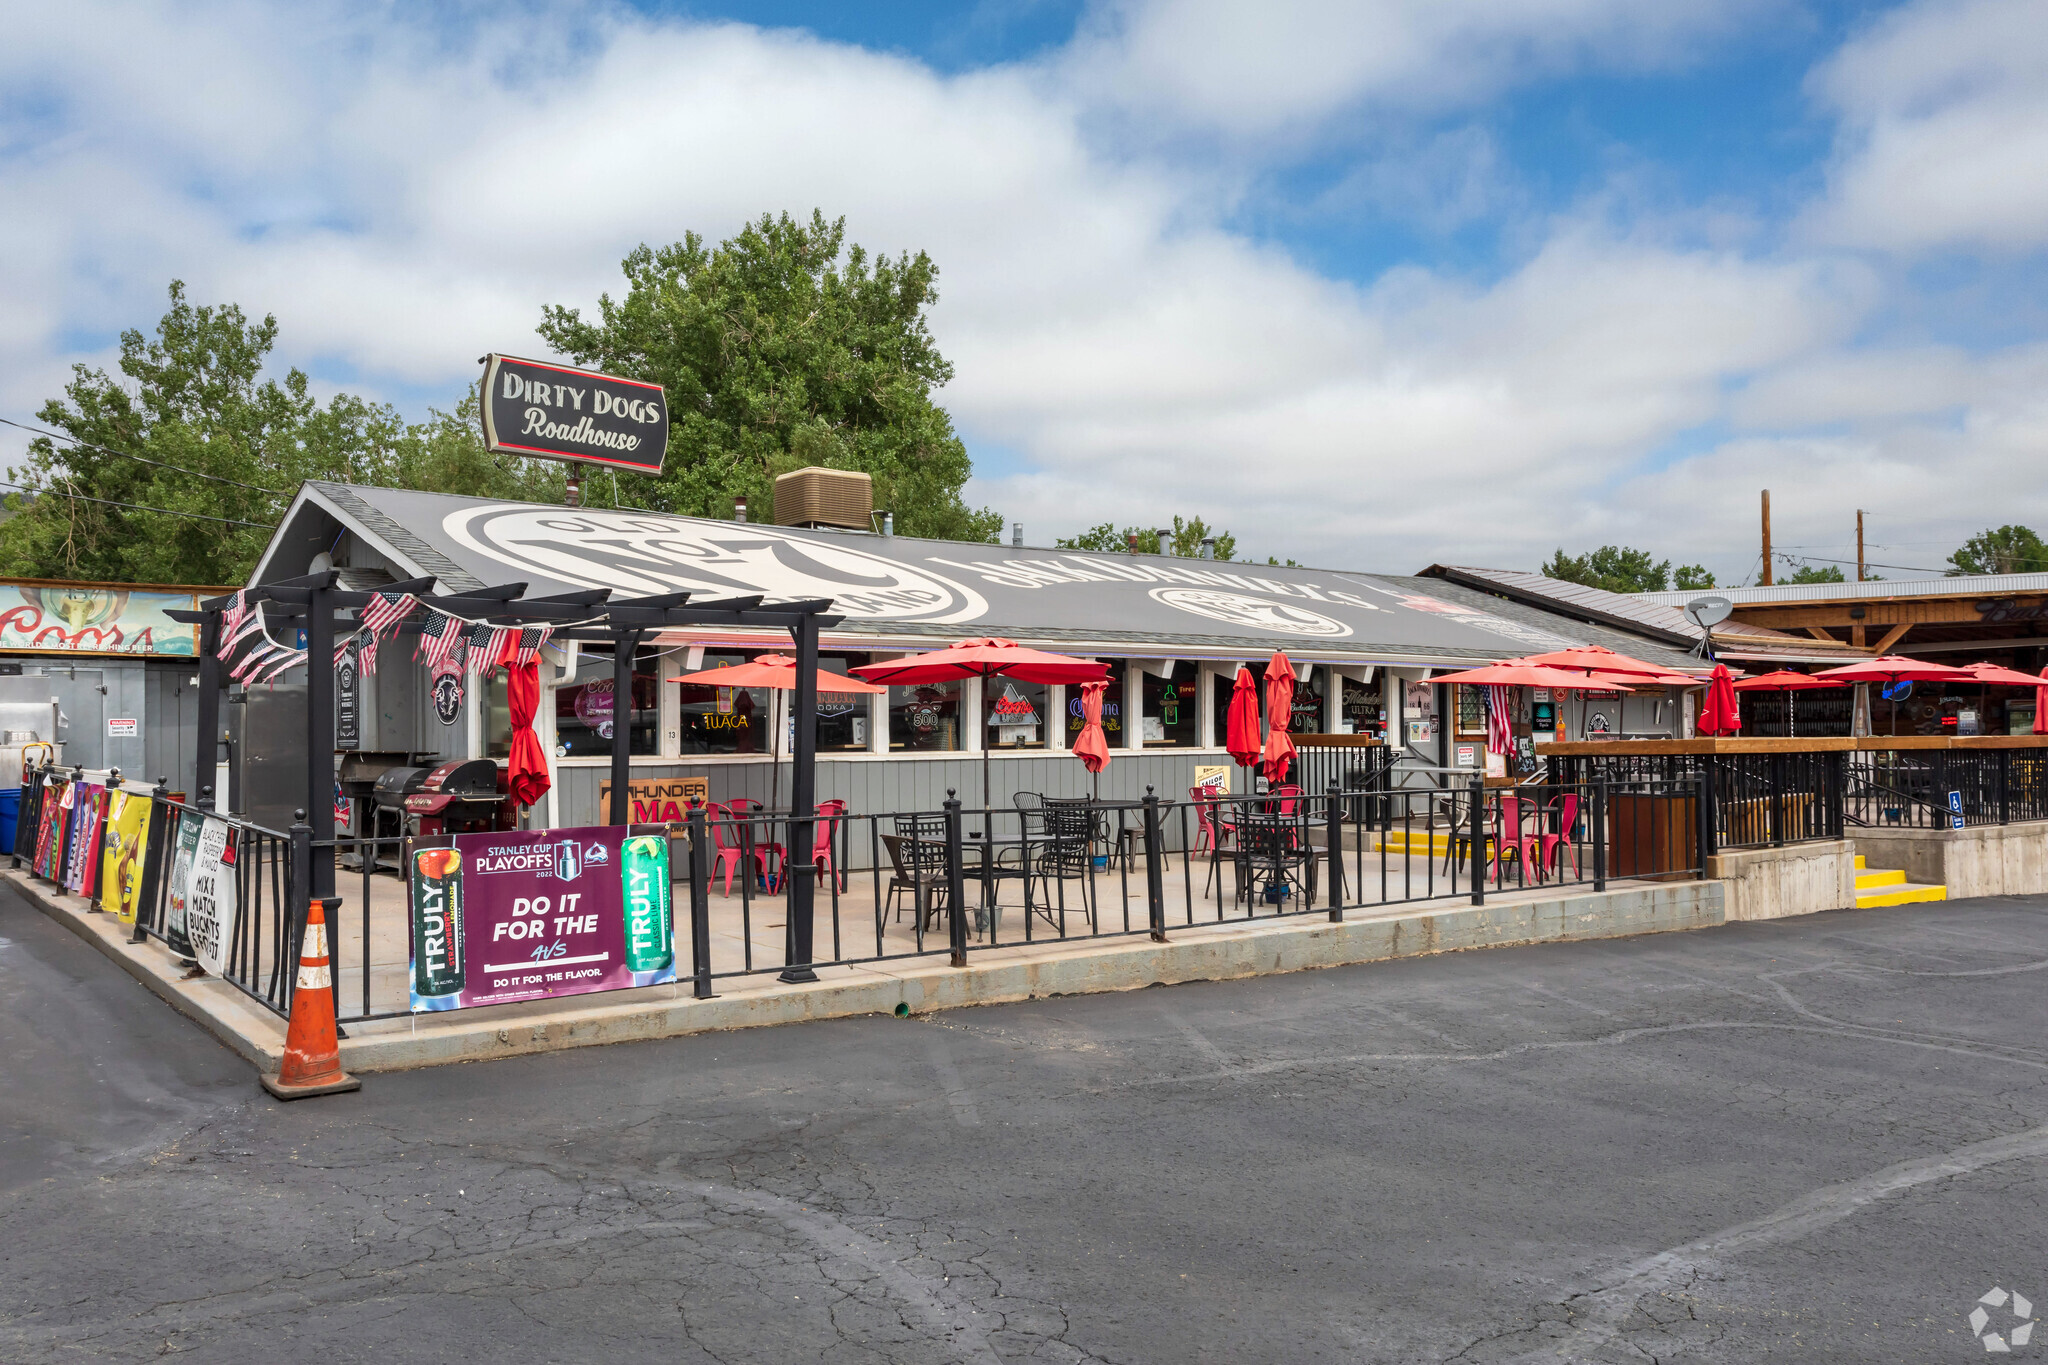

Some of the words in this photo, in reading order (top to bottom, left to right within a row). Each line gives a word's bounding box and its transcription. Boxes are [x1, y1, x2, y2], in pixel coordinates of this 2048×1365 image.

[502, 371, 586, 411] DIRTY
[593, 389, 660, 424] DOGS
[521, 407, 642, 451] Roadhouse
[536, 517, 681, 533] OLD
[699, 538, 900, 588] 7
[925, 556, 1128, 589] JACK
[761, 589, 943, 614] RAND
[1243, 603, 1320, 624] 7
[0, 606, 159, 654] Coors
[51, 642, 75, 650] MOST
[131, 644, 154, 653] BEER
[587, 677, 615, 694] Coo
[995, 696, 1034, 715] Coors
[1069, 697, 1120, 719] Cna
[1351, 705, 1376, 715] ULTRA
[702, 712, 749, 730] TUACA
[913, 713, 939, 727] 500
[668, 731, 676, 739] 13
[1201, 775, 1223, 788] SAILOR
[631, 799, 706, 825] MAX
[488, 844, 532, 857] STANLEY
[533, 843, 552, 854] CUP
[476, 853, 553, 872] PLAYOFFS
[196, 874, 209, 895] MIX
[192, 893, 216, 919] MATCH
[512, 896, 551, 917] DO
[558, 893, 582, 913] IT
[629, 867, 652, 955] TRULY
[650, 899, 658, 918] LIME
[190, 911, 220, 941] BUCKTS
[422, 882, 446, 979] TRULY
[492, 919, 545, 942] FOR
[553, 914, 599, 936] THE
[651, 918, 661, 949] CLASSIC
[444, 911, 456, 967] STRAWBERRY
[530, 938, 567, 966] AVS
[493, 979, 509, 988] DO
[511, 977, 520, 986] IT
[522, 974, 543, 985] FOR
[545, 972, 563, 982] THE
[565, 968, 603, 980] FLAVOR.
